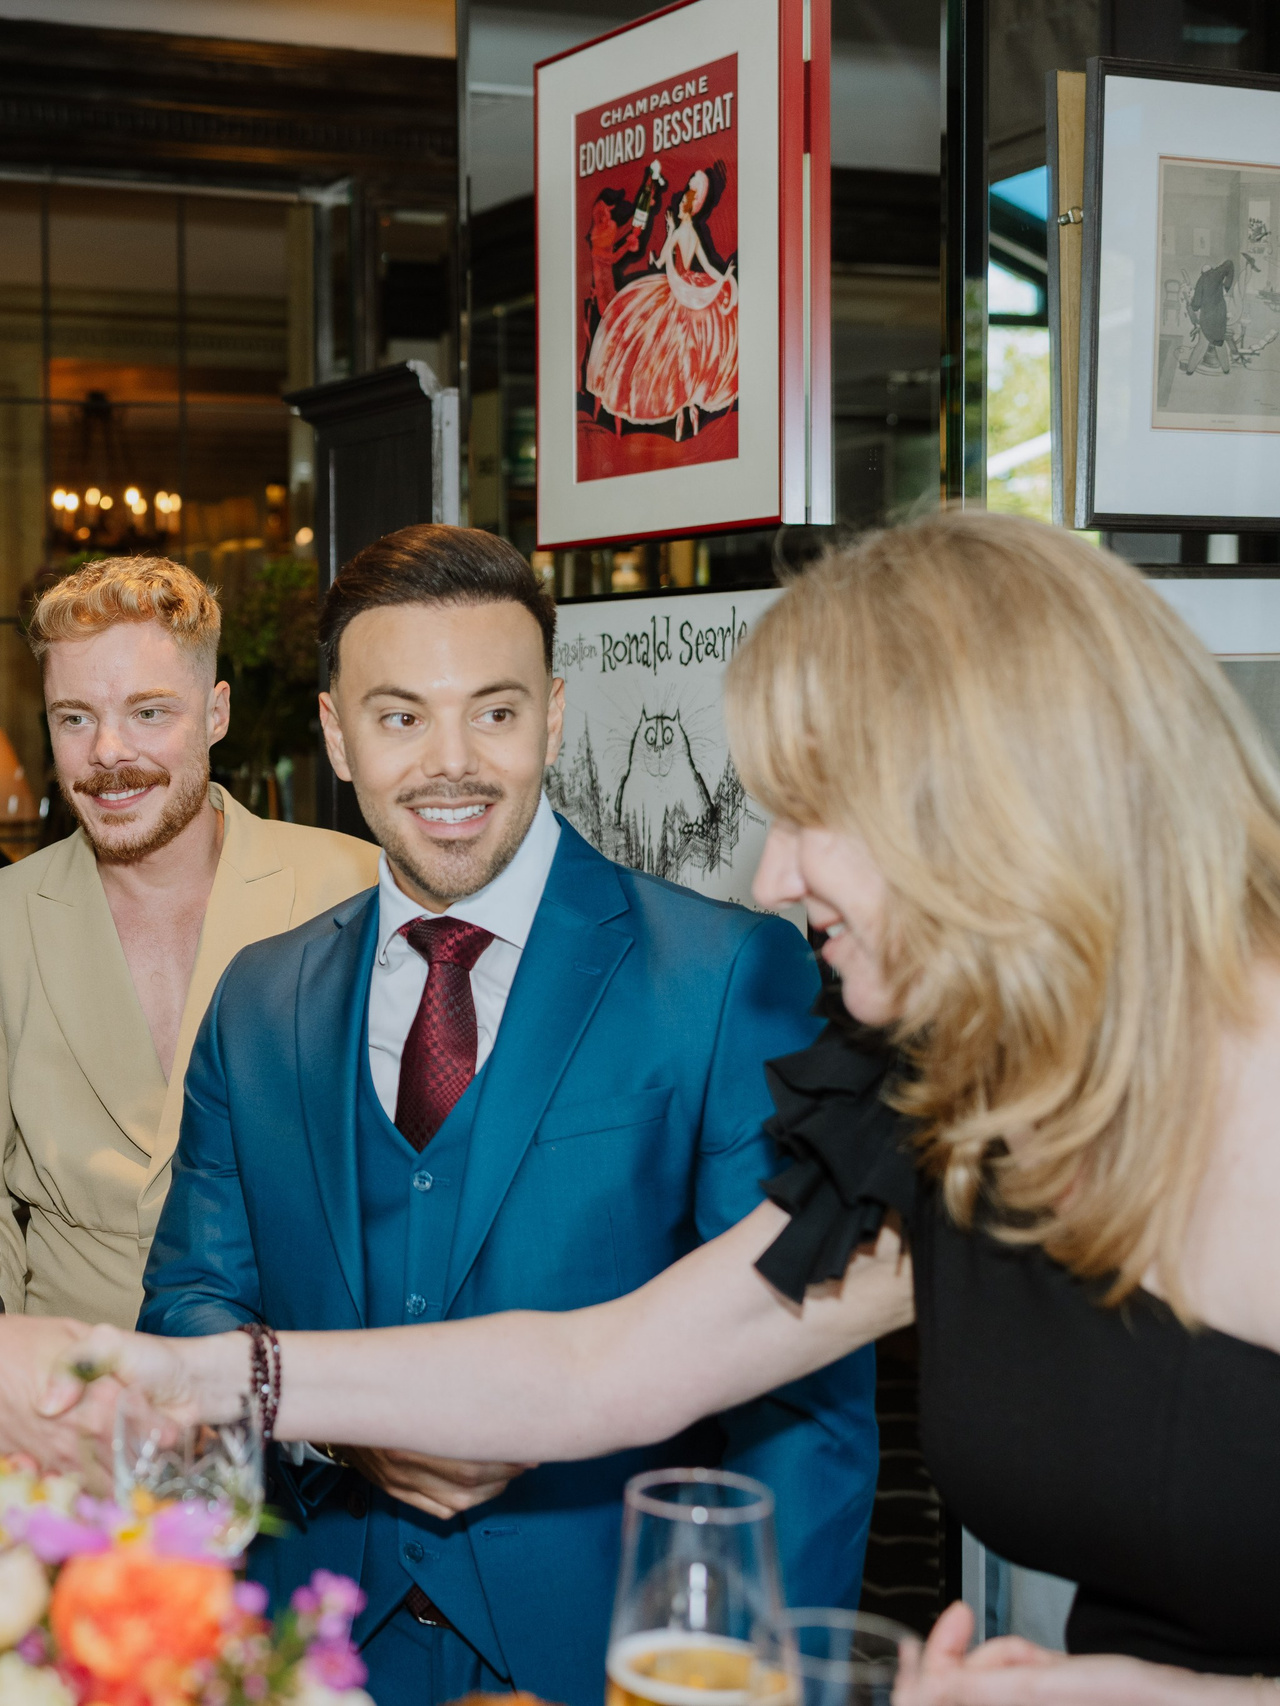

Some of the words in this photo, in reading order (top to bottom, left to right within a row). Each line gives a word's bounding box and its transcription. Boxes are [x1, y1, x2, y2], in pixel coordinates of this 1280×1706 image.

[600, 75, 709, 129] CHAMPAGNE
[579, 123, 647, 178] EDOUARD
[652, 91, 734, 154] BESSERAT
[598, 615, 672, 676] Ronald
